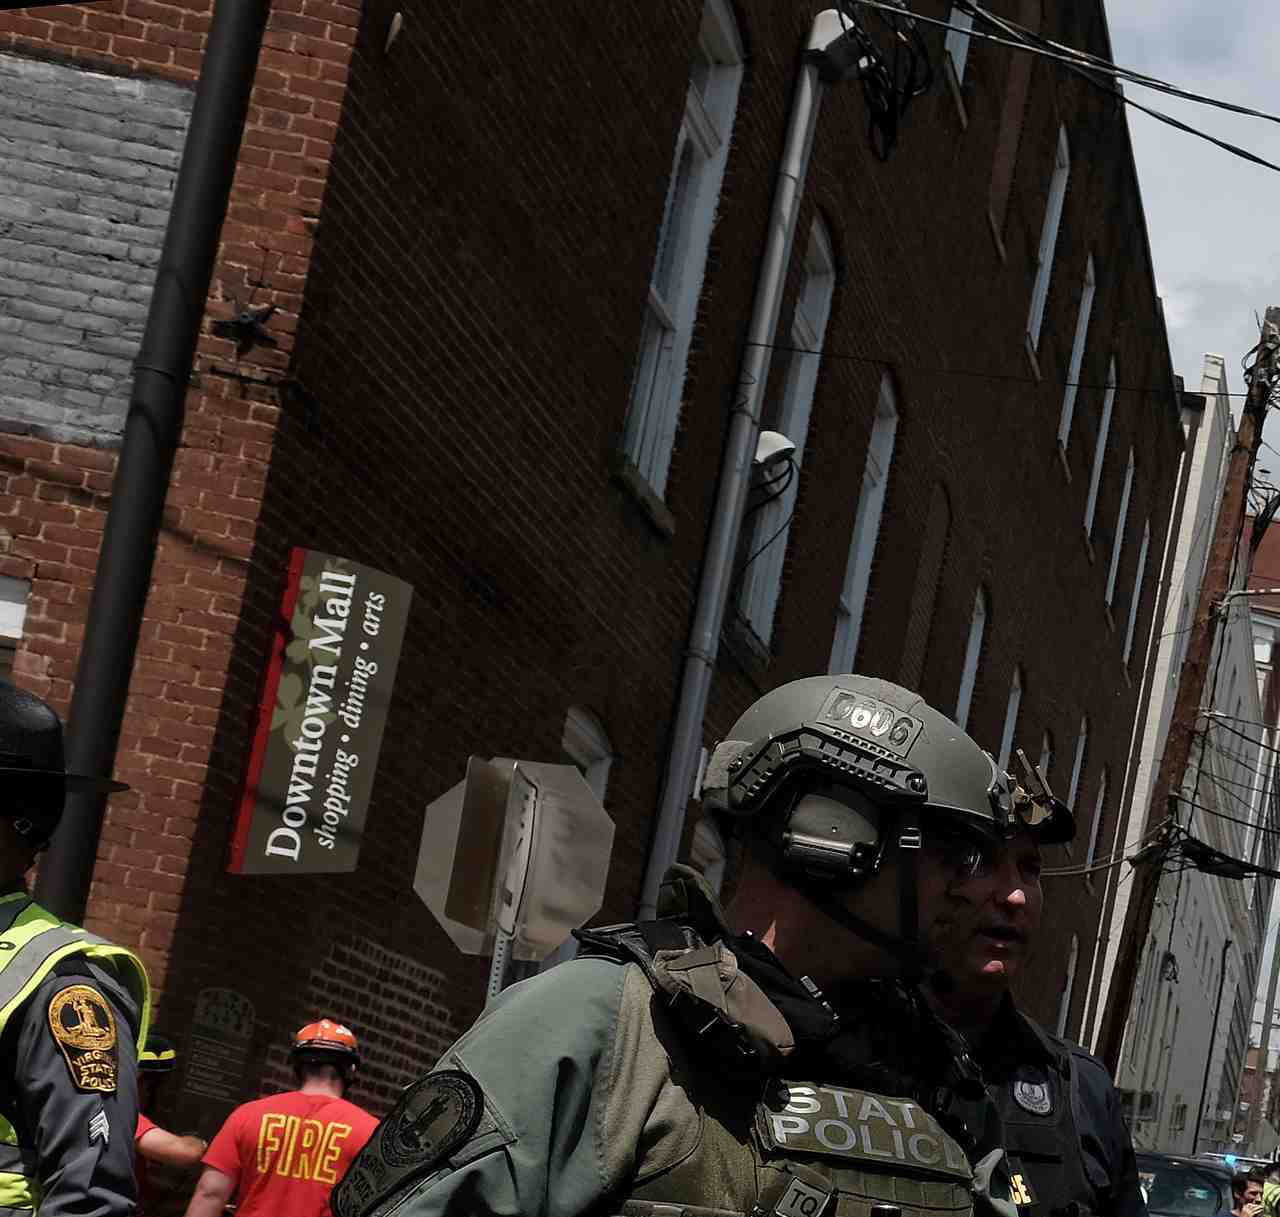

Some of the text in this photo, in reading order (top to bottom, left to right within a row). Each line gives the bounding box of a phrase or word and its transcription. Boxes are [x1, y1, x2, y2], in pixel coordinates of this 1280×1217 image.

[265, 571, 357, 861] Downtown Mall
[313, 591, 386, 850] shopping dining arts
[256, 1112, 353, 1185] FIRE
[784, 1086, 916, 1129] STAT
